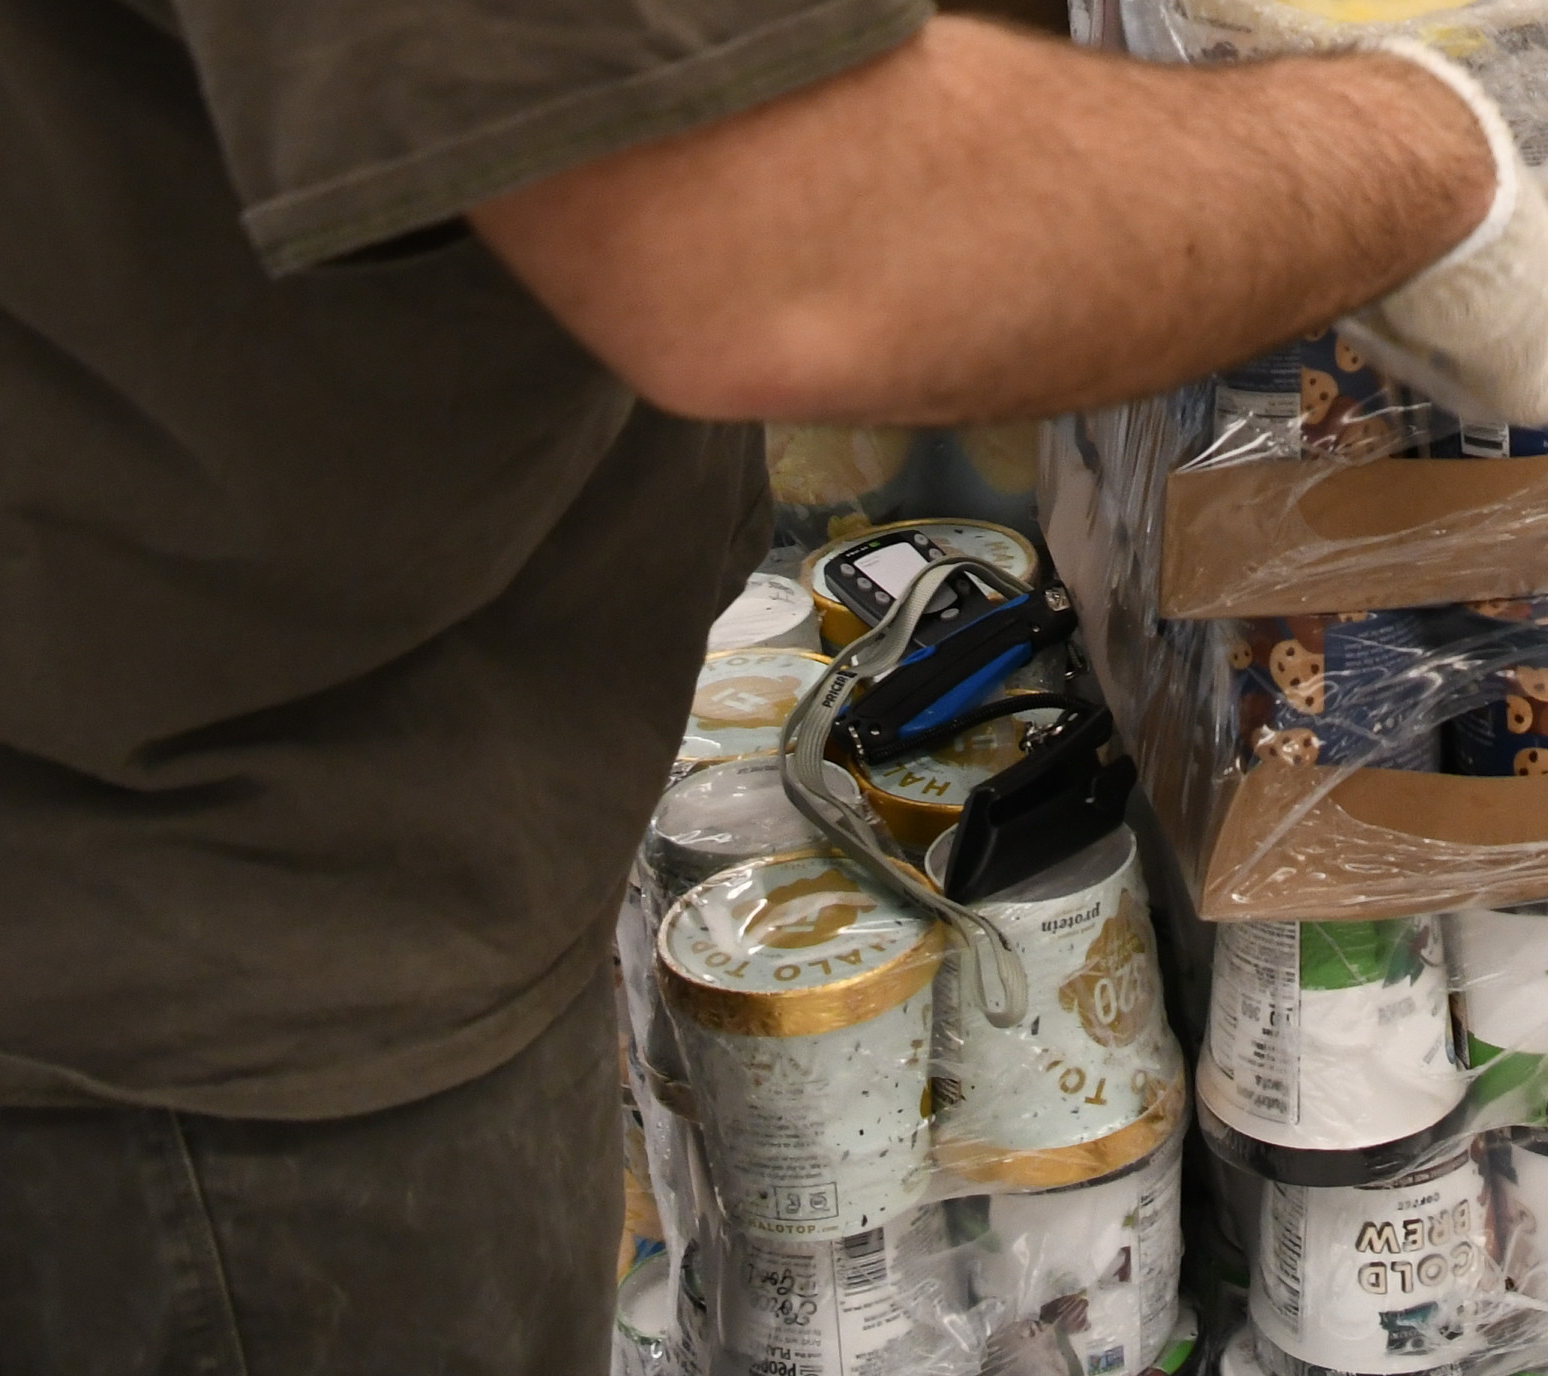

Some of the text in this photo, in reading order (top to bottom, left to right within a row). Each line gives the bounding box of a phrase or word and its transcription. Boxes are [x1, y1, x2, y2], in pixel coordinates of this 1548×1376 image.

[823, 671, 848, 708] PRICER
[882, 761, 951, 797] HAL
[1040, 901, 1101, 934] protein
[1356, 1199, 1471, 1254] BREW
